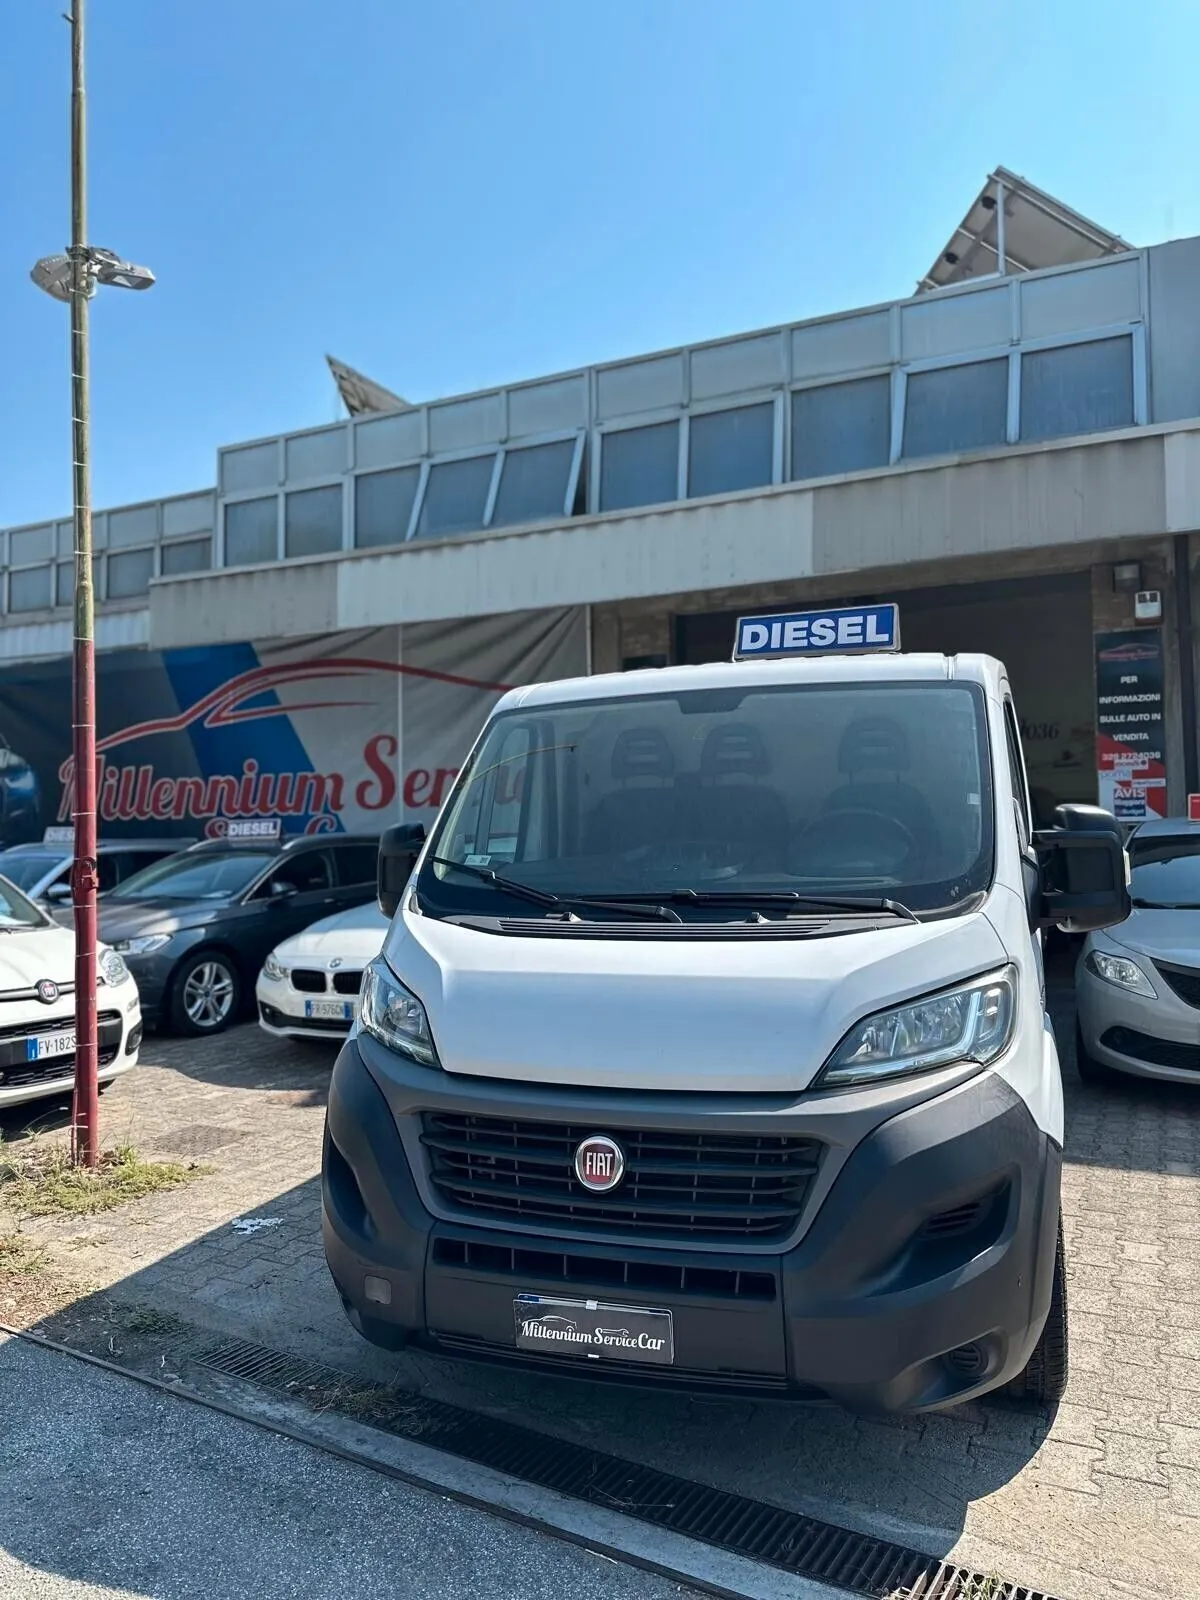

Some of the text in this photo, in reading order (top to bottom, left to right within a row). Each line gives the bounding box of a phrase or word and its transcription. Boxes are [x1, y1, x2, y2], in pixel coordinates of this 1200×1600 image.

[741, 615, 889, 650] DIESEL
[1120, 675, 1138, 684] PER
[1099, 693, 1160, 704] INFORMAZIONI
[1100, 712, 1161, 723] SULLE AUTO IN
[1113, 733, 1149, 742] VENDITA
[1115, 789, 1145, 799] AVIS
[229, 821, 277, 836] DIESEL
[586, 1151, 614, 1177] FIAT
[521, 1320, 593, 1344] Millennium
